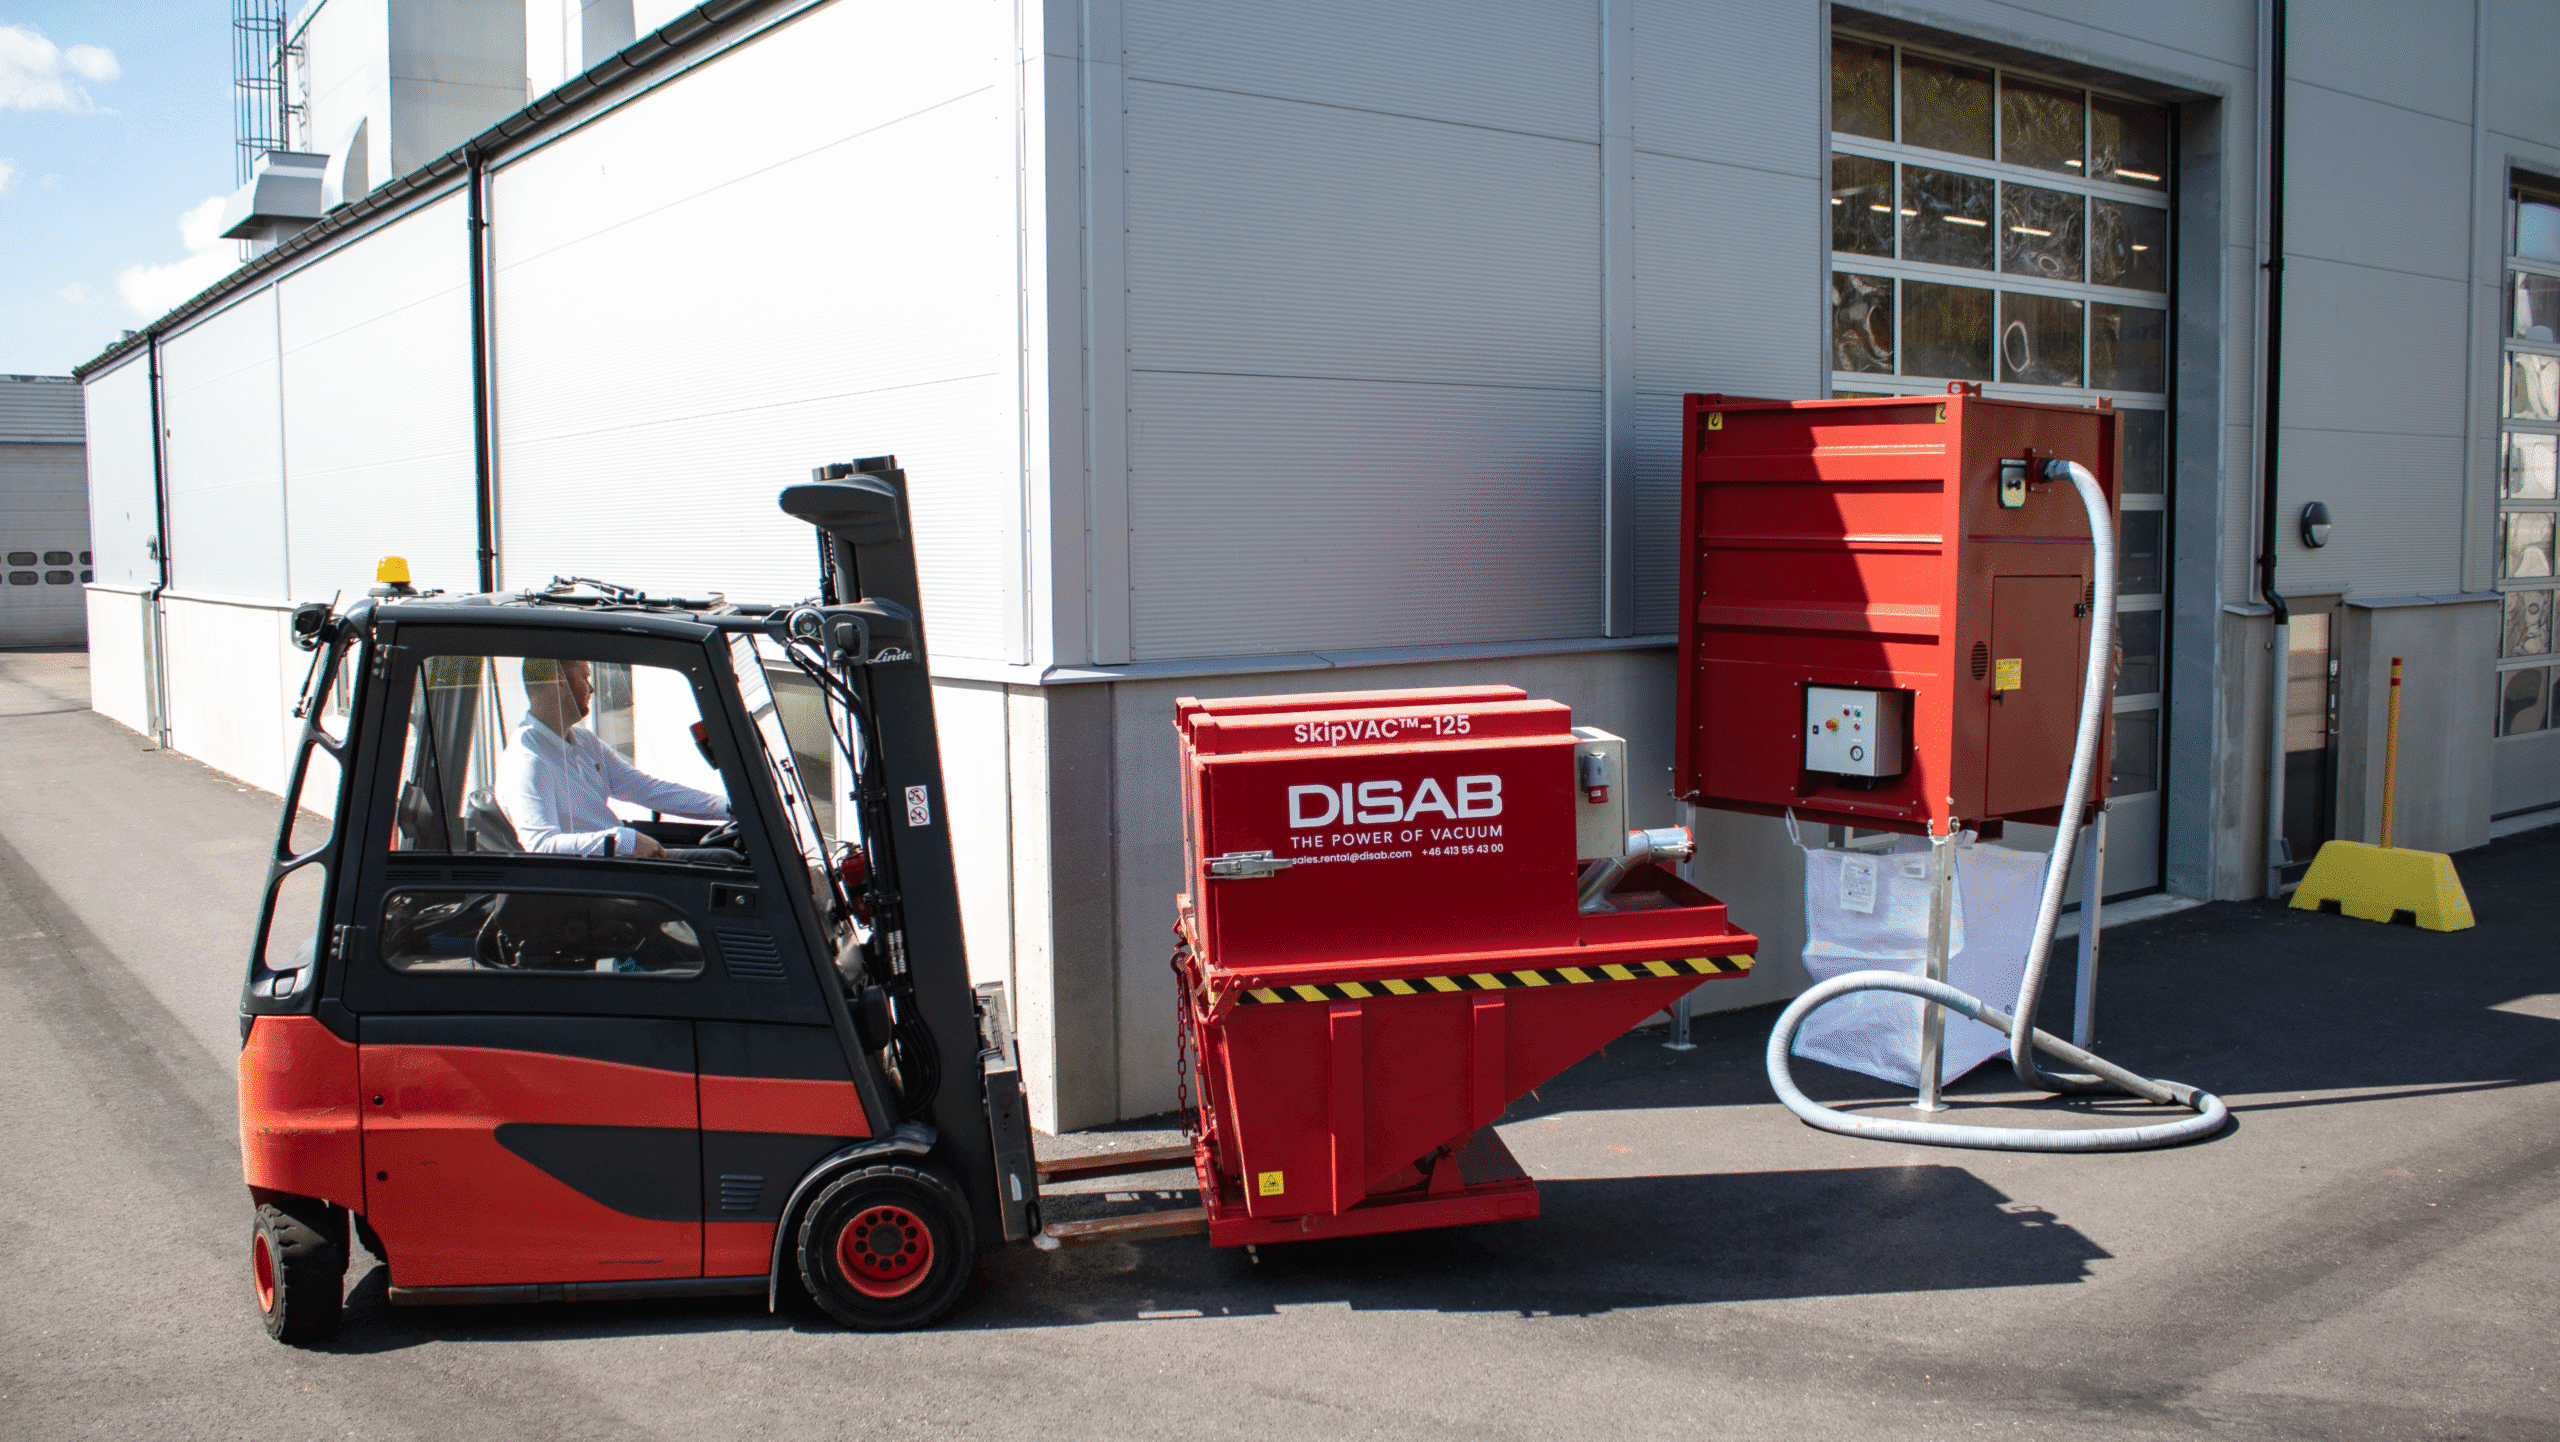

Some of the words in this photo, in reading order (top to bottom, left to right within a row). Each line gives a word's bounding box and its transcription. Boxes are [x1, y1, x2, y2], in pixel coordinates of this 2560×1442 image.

[866, 647, 913, 664] Linde
[1288, 774, 1503, 829] DISAB
[1291, 835, 1324, 849] THE
[1332, 831, 1393, 847] POWER
[1401, 829, 1424, 843] OF
[1431, 825, 1503, 841] VACUUM
[1292, 849, 1412, 865] sales.rental@disab.com
[1422, 847, 1441, 857] +46
[1444, 845, 1460, 856] 413
[1462, 845, 1474, 855] 55
[1477, 844, 1489, 854] 43
[1491, 843, 1504, 854] 00
